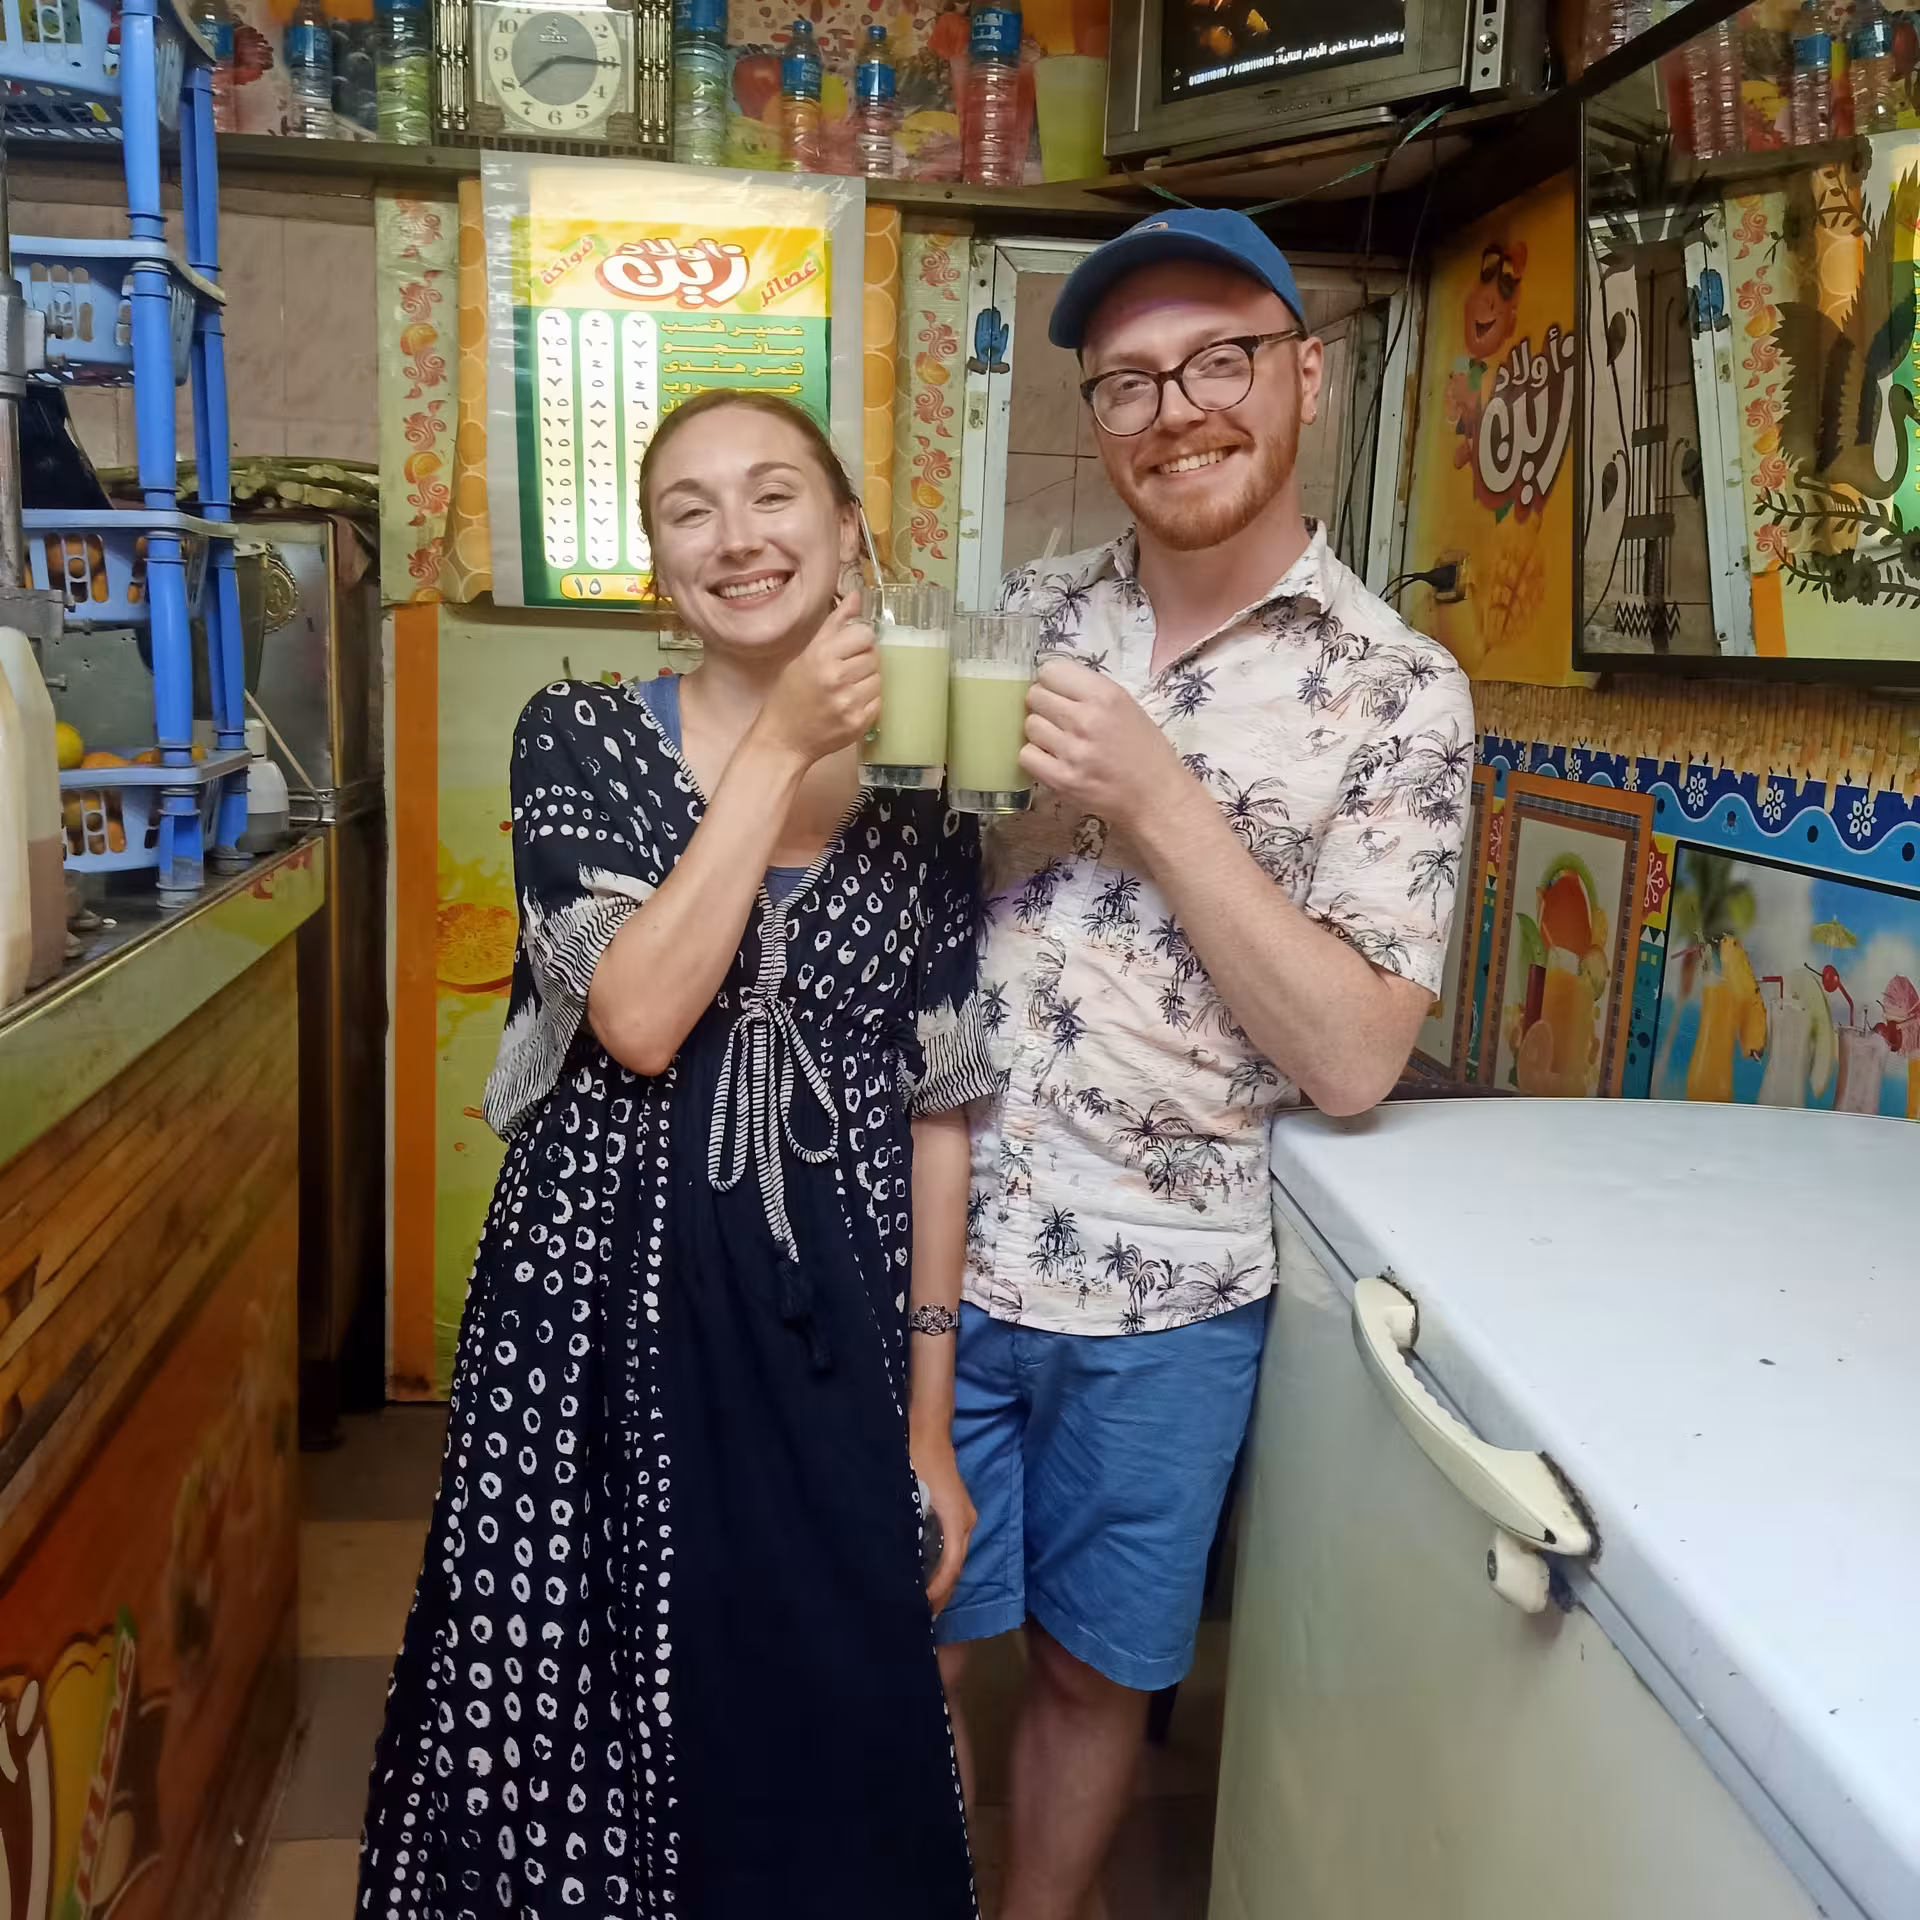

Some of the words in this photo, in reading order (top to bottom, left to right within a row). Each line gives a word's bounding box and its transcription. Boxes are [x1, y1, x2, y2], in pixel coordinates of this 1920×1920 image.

[498, 19, 518, 34] 10
[594, 24, 609, 39] 2
[494, 47, 508, 62] 9
[1328, 43, 1348, 55] على
[501, 78, 516, 92] 8
[593, 85, 607, 99] 4
[520, 101, 533, 116] 7
[575, 104, 590, 119] 5
[548, 111, 562, 125] 6
[603, 244, 750, 305] زين
[761, 259, 818, 308] عصائر
[660, 319, 727, 335] قصب
[728, 325, 805, 338] عصير
[631, 340, 647, 349] ٧
[660, 342, 805, 356] مانجو
[1495, 328, 1560, 392] أولاد
[750, 362, 805, 376] تمر
[547, 377, 563, 387] ٧
[590, 400, 607, 409] ٨
[590, 419, 607, 428] ٧
[1479, 336, 1575, 505] زين
[591, 440, 608, 448] ٨
[574, 576, 602, 597] ١٥
